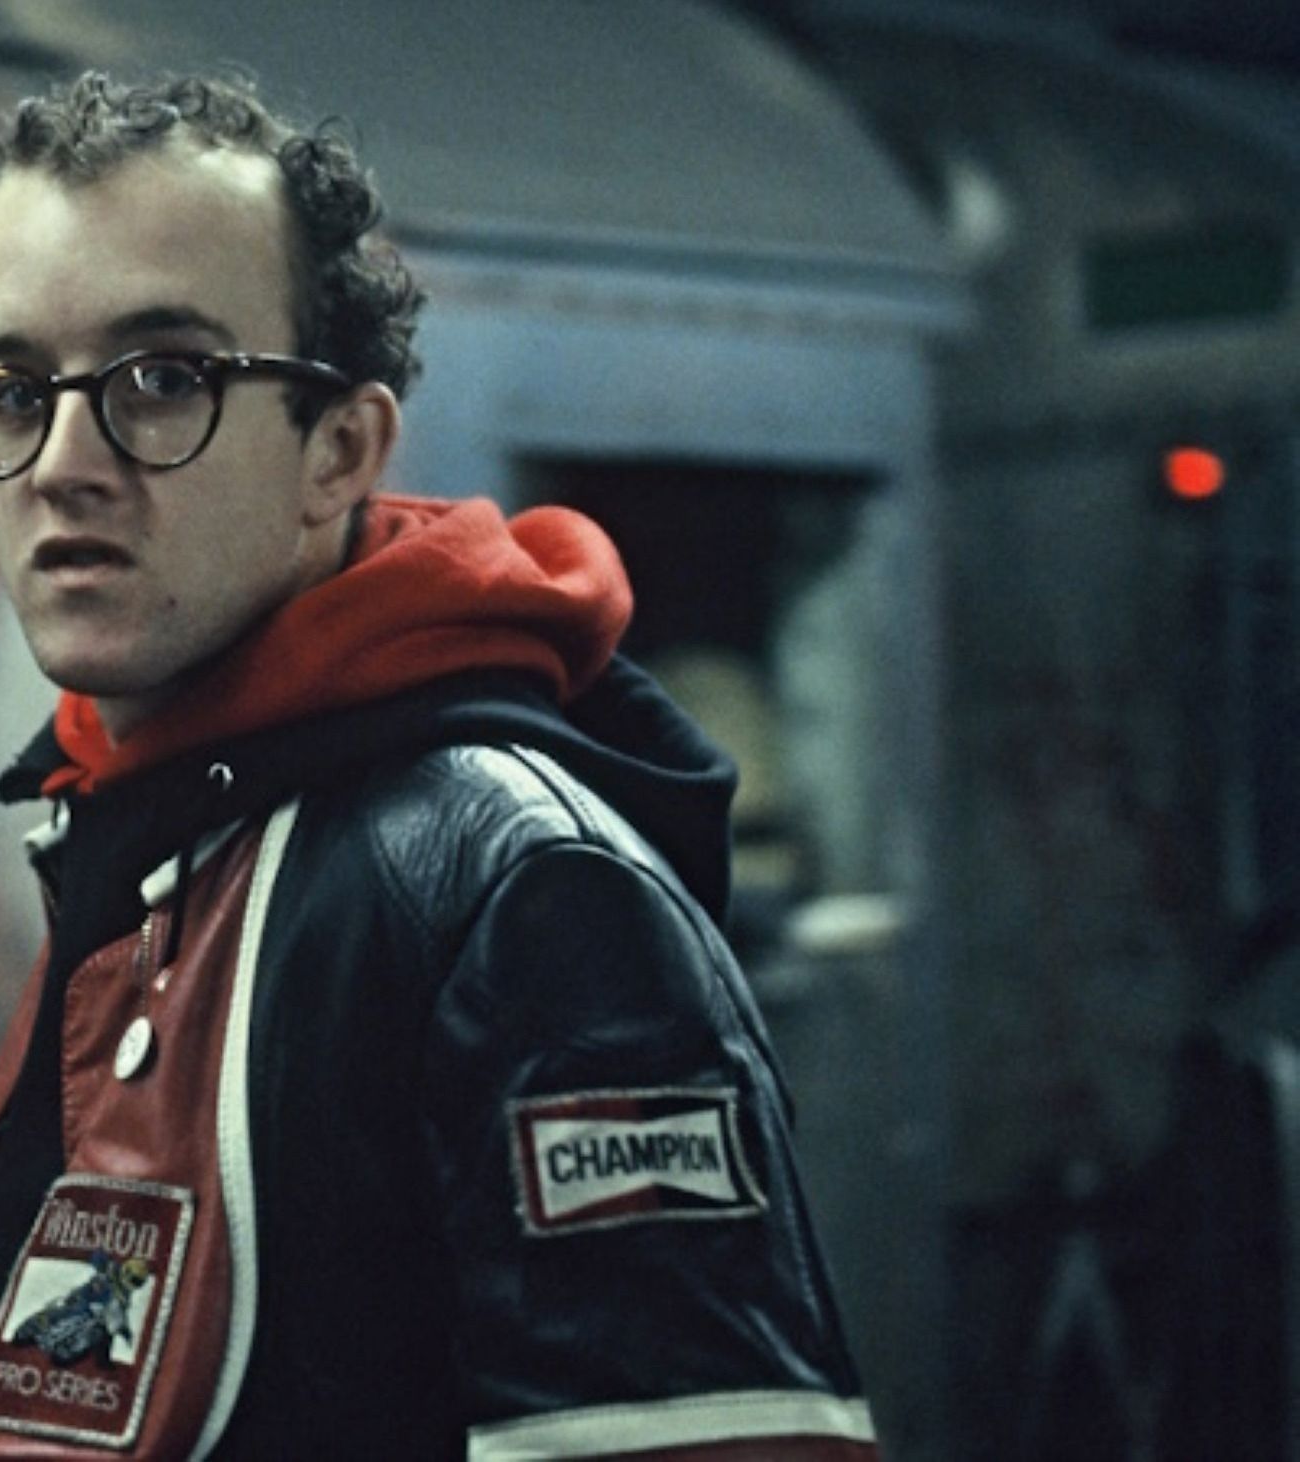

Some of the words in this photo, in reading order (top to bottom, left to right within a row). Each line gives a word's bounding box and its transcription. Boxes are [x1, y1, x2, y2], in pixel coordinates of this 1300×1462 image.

[547, 1133, 720, 1183] CHAMPION
[41, 1199, 159, 1260] Winston
[43, 1370, 120, 1411] SERIES
